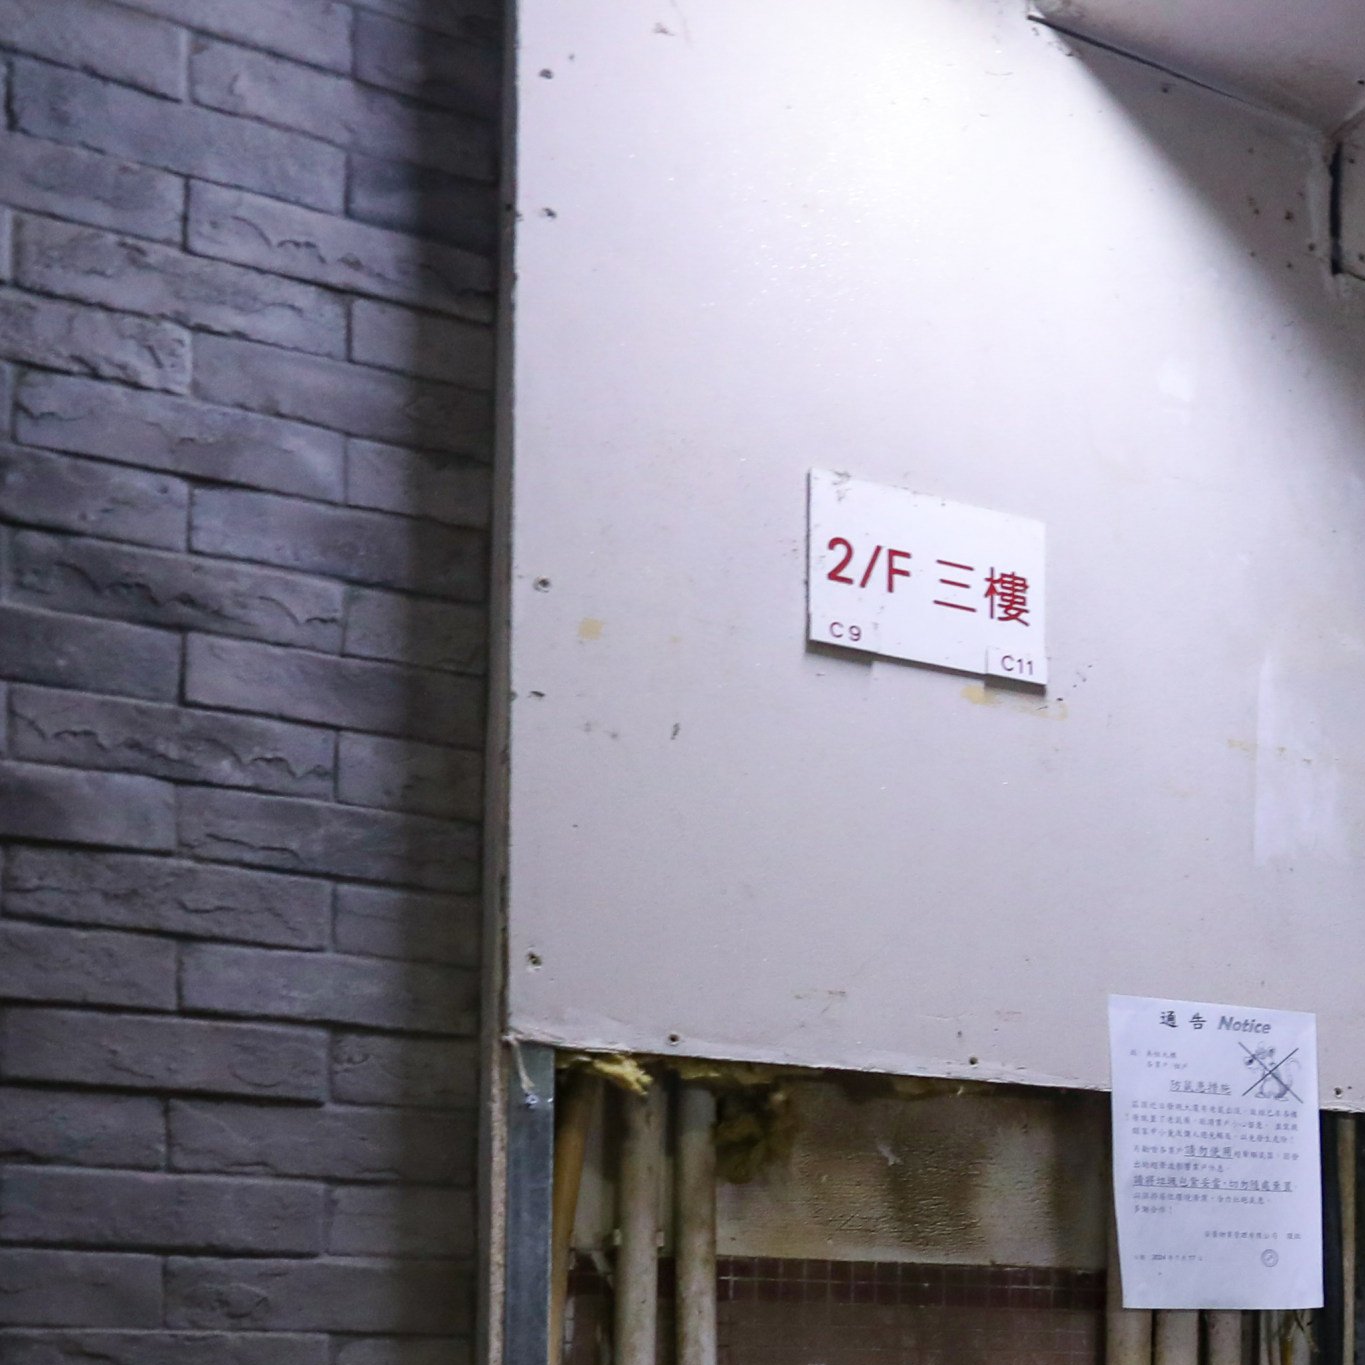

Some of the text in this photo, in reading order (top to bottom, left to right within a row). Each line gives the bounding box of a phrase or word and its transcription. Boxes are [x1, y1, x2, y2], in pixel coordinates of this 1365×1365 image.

[827, 537, 1030, 627] 2/F 三樓
[829, 621, 862, 642] C9
[1001, 655, 1034, 676] C11
[1217, 1016, 1272, 1034] Notice
